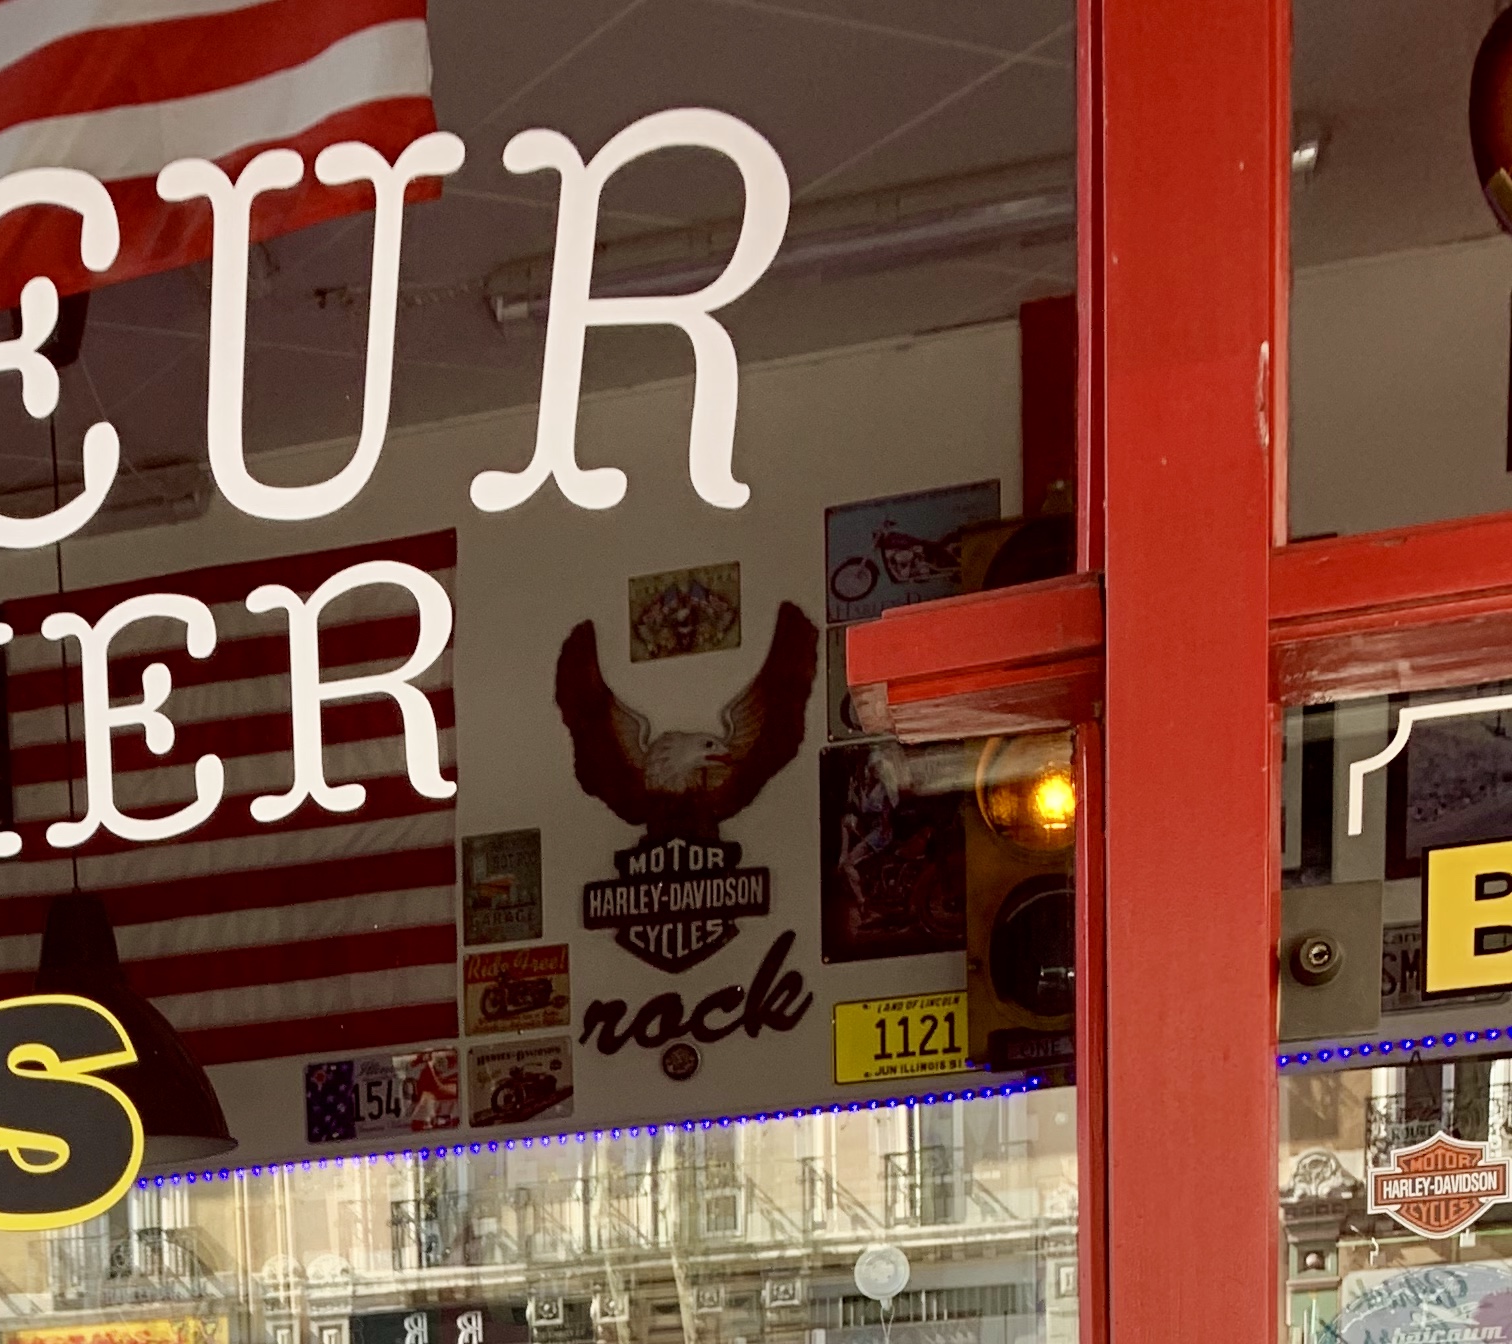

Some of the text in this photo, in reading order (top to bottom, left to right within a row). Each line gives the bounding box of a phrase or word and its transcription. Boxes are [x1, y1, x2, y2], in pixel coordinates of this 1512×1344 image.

[629, 837, 724, 876] MOTOR
[589, 875, 764, 918] HARLEY-DAVIDSON
[629, 919, 724, 960] CYCLES
[579, 928, 815, 1056] rock
[874, 1012, 962, 1060] 1121
[875, 1065, 897, 1076] JUN
[900, 1061, 946, 1074] ILLINOIS
[1410, 1148, 1471, 1171] MOTOR
[1383, 1171, 1498, 1200] HARLEY-DAVIDSON
[1408, 1200, 1471, 1227] CYCLES
